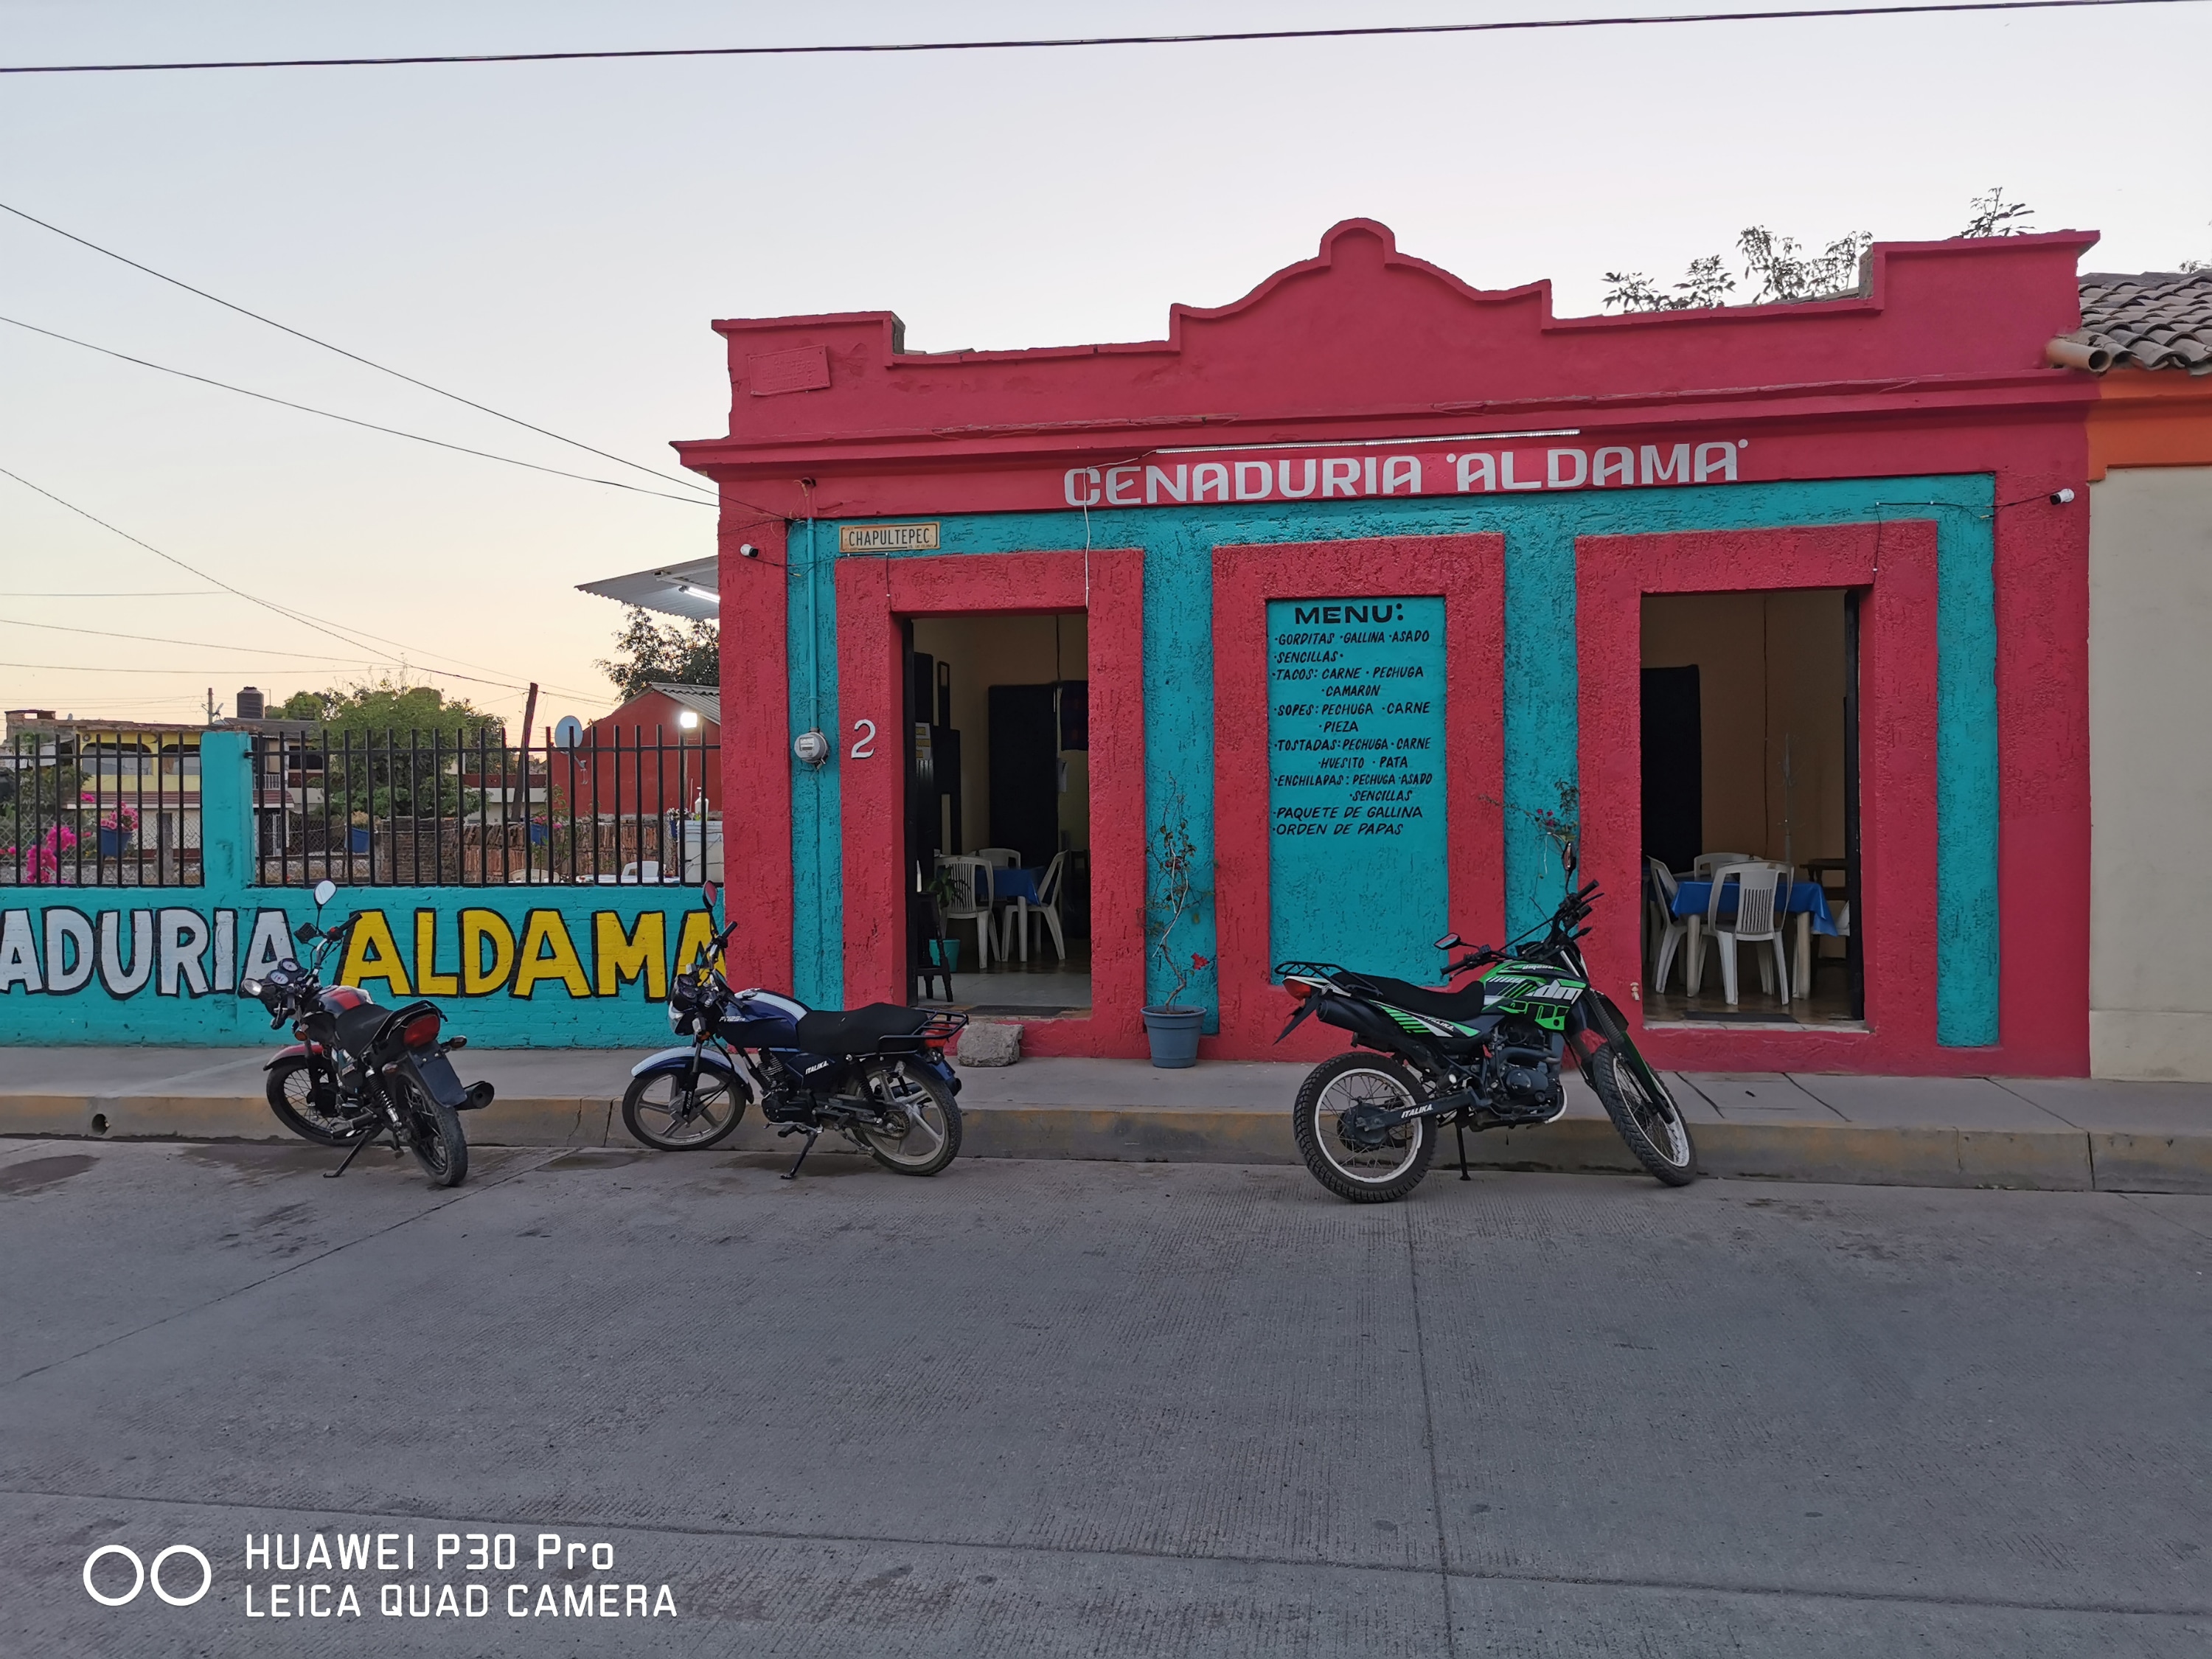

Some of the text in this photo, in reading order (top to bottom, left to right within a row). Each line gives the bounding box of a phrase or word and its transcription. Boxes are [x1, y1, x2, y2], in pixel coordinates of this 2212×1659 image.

[1064, 456, 1422, 507] CENADURIA
[849, 528, 930, 546] CHAPULTEPEC
[1295, 603, 1404, 625] MENU:
[1279, 630, 1430, 645] GORDITAS GALLINA ASADO
[1276, 666, 1424, 681] TACOS: CARNE PECHUGA
[1326, 685, 1381, 697] CAMARON
[1278, 702, 1430, 716] SOPES: PECHUGA CARNE
[1324, 721, 1359, 733] PIEZA
[851, 719, 876, 759] 2
[1343, 738, 1388, 750] PECHUGA
[1397, 737, 1432, 750] CARNE
[1321, 756, 1408, 769] HUESITO PATA
[1352, 773, 1396, 785] PECHUGA
[1401, 773, 1433, 785] ASADO
[1352, 790, 1413, 801] SENCILLAS
[1276, 807, 1423, 821] PAQUETE DE GALLINA
[1276, 823, 1404, 835] ORDEN DE PAPAS
[0, 905, 726, 1004] ADURIA ALDAMA
[805, 1060, 829, 1075] ITALIKA
[1401, 1104, 1433, 1119] ITALIKA
